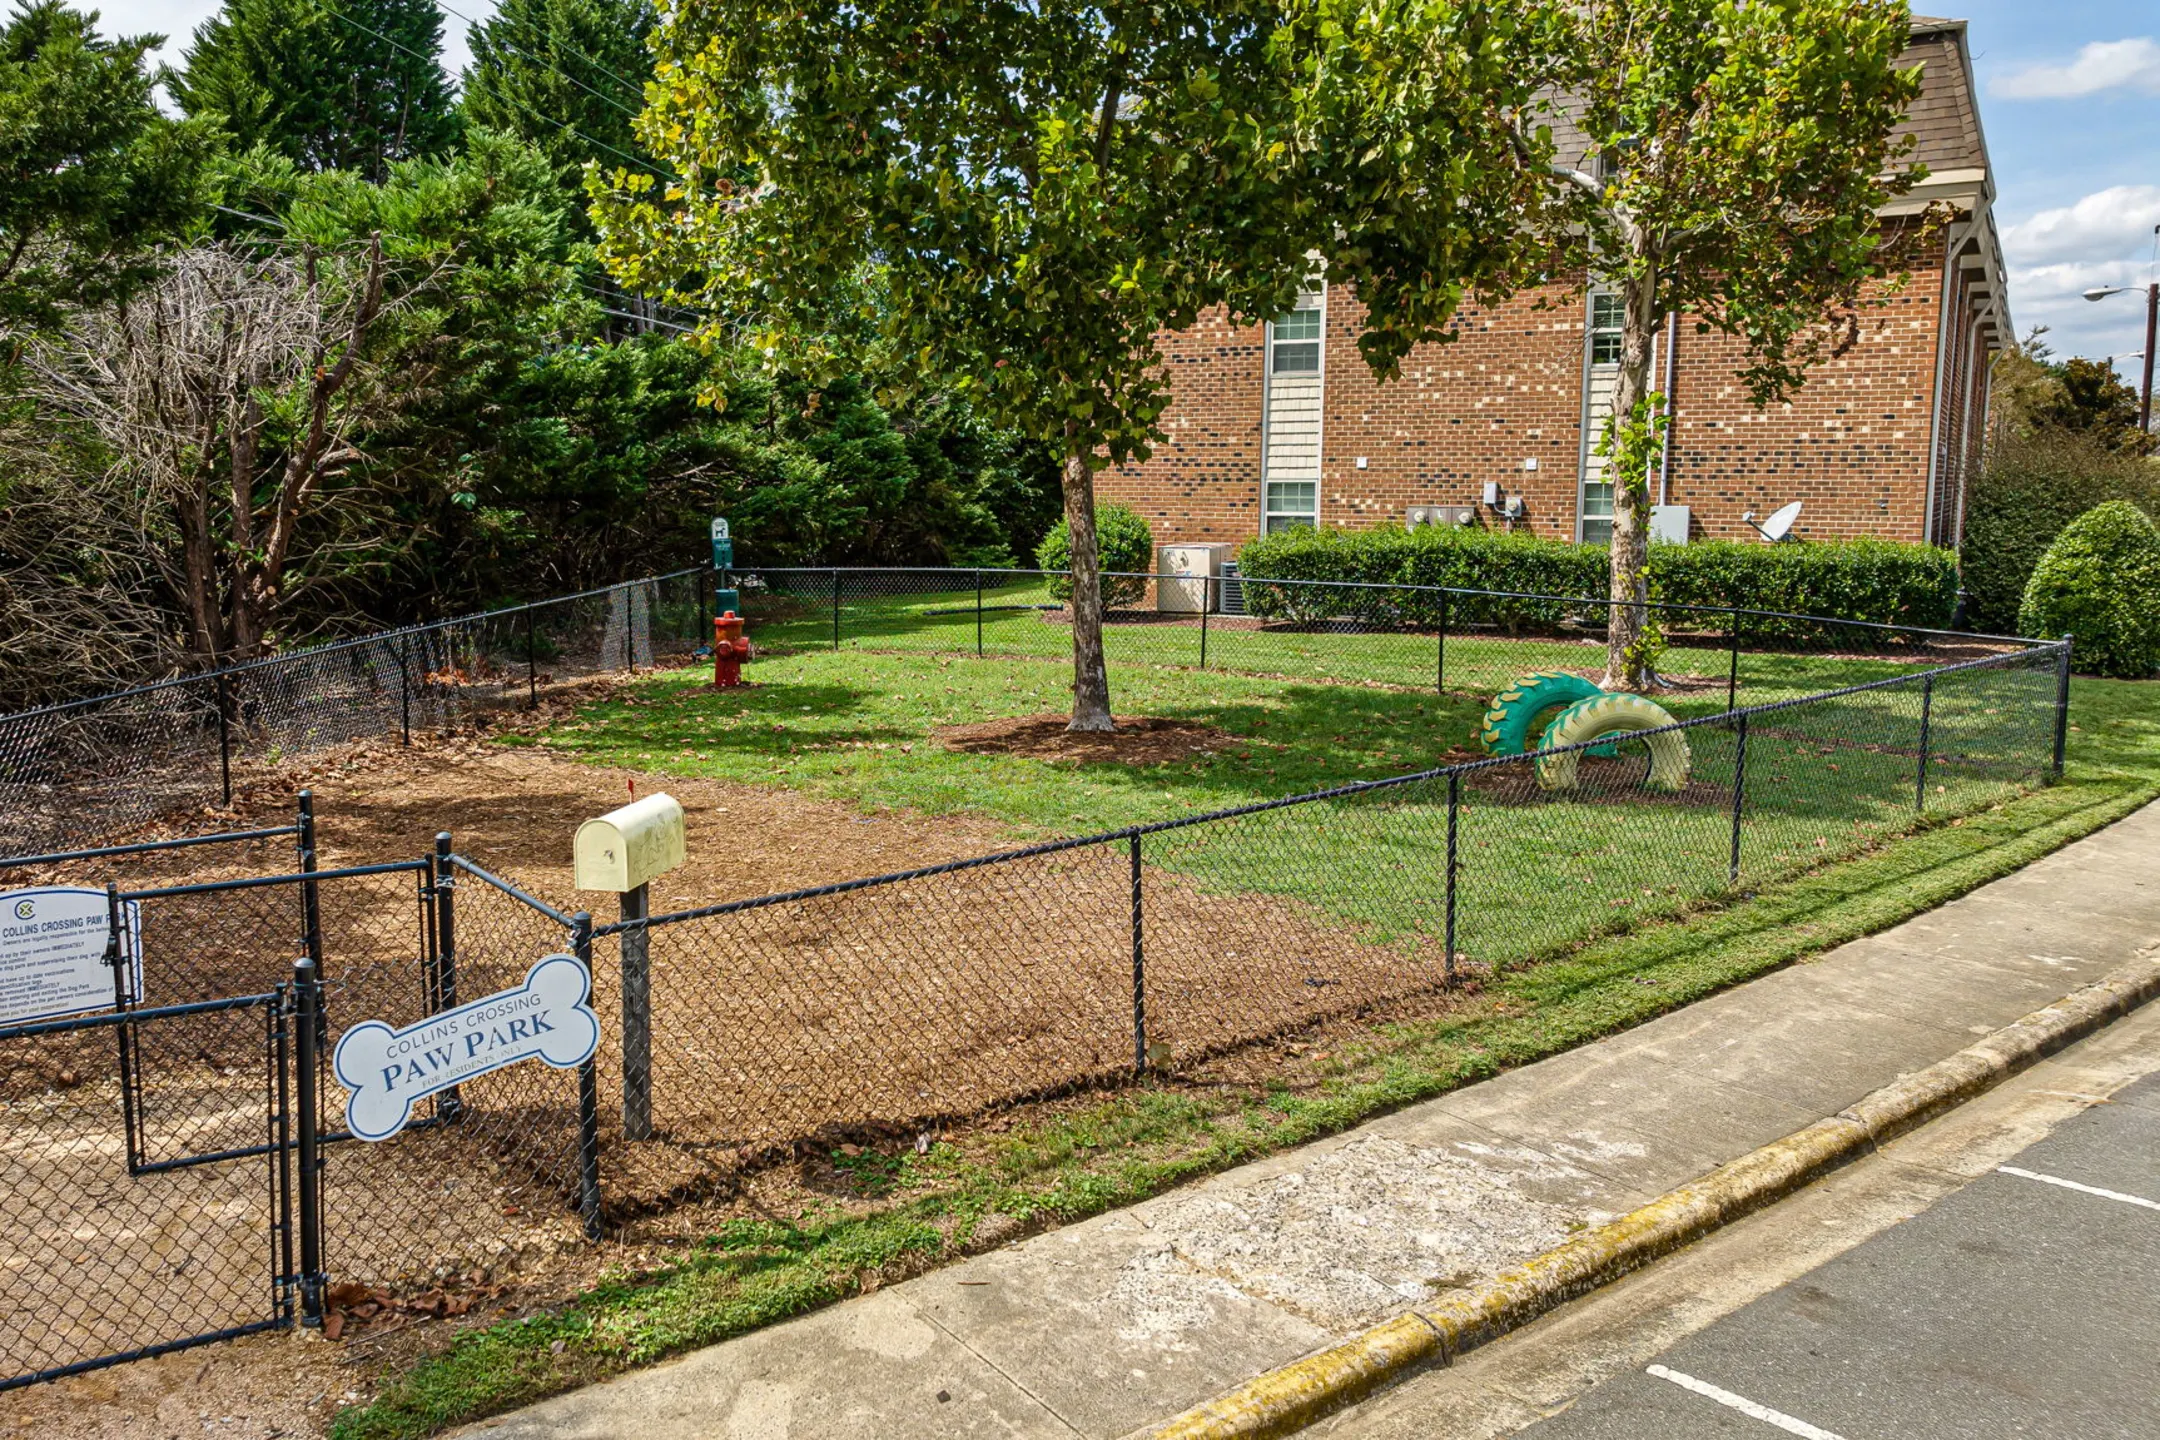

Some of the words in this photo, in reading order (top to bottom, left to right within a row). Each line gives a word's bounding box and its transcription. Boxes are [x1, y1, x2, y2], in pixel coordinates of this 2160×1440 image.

[2, 924, 39, 938] COLLINS
[41, 917, 83, 932] CROSSING
[86, 914, 103, 926] PAW
[386, 1021, 458, 1058] COLLINS
[466, 994, 541, 1028] CROSSING
[380, 1042, 454, 1092] PAW
[462, 1010, 555, 1058] PARK
[422, 1074, 441, 1088] FOR
